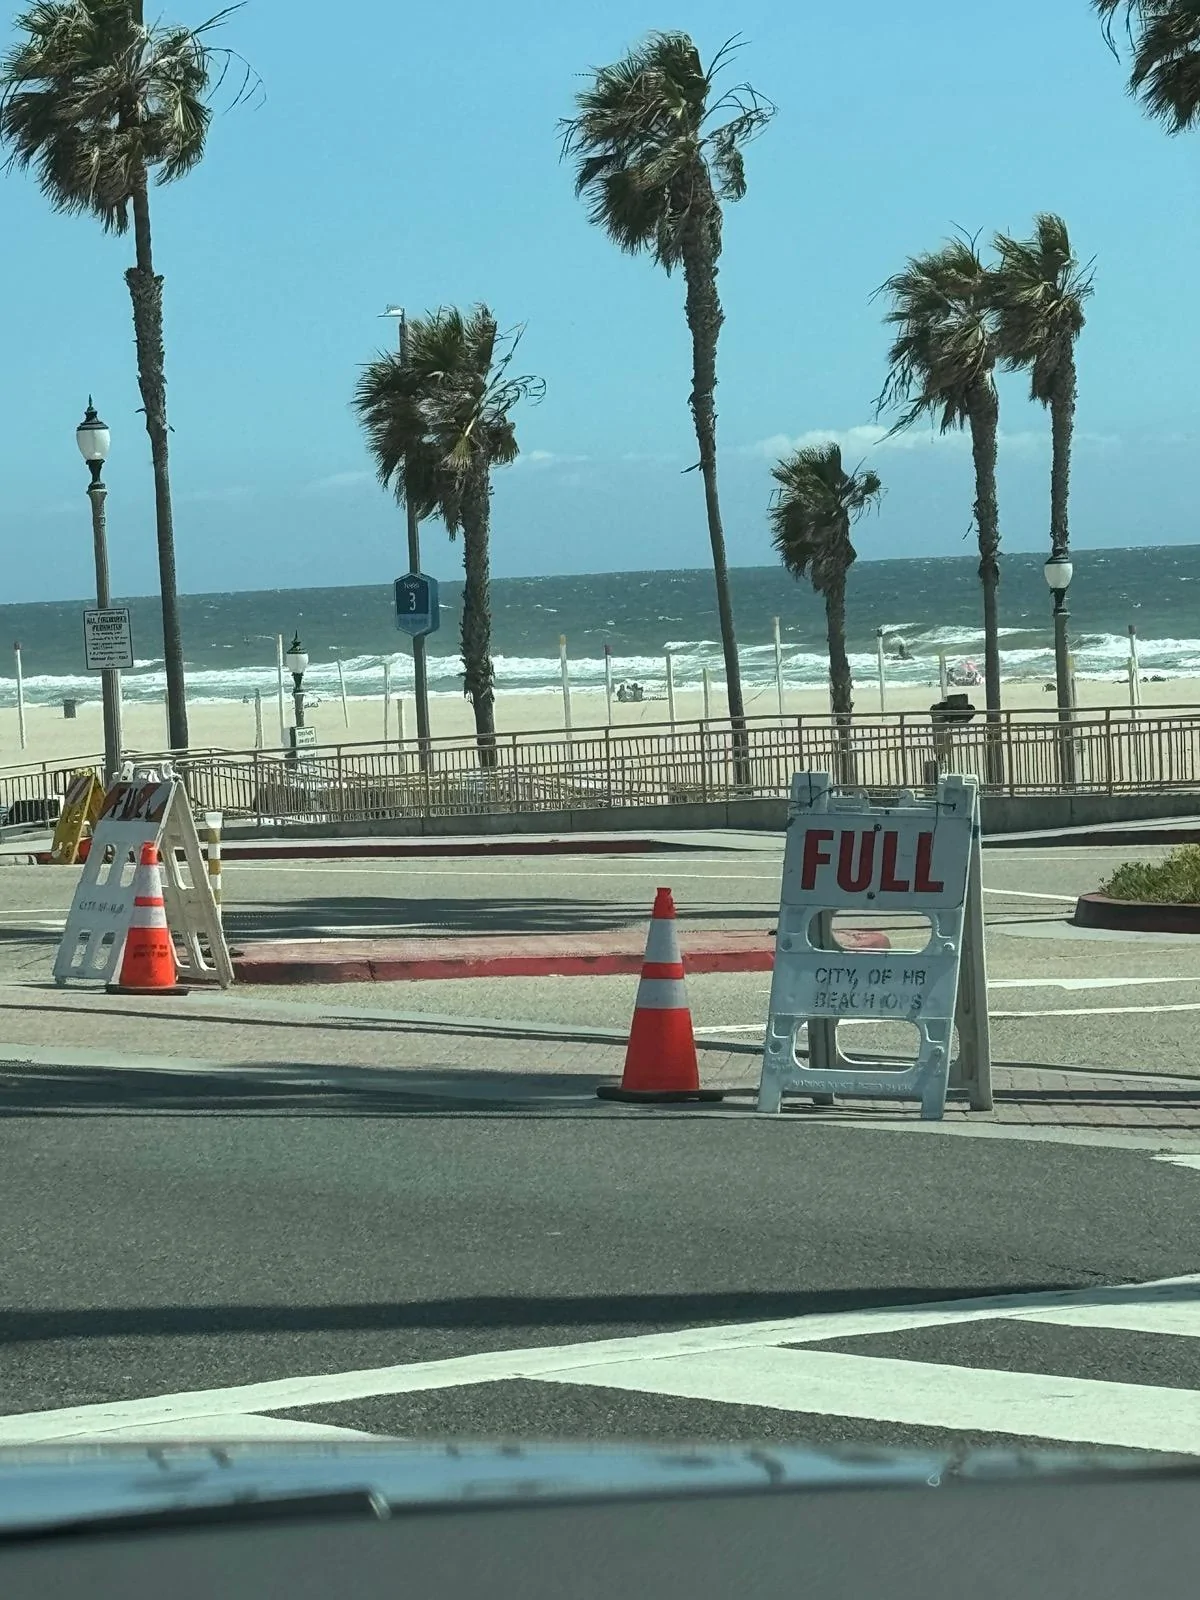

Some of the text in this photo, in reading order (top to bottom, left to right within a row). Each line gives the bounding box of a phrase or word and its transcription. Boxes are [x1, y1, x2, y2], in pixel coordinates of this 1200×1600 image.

[409, 592, 416, 611] 3
[801, 829, 944, 893] FULL
[868, 968, 893, 985] OF
[814, 991, 875, 1010] BEACH
